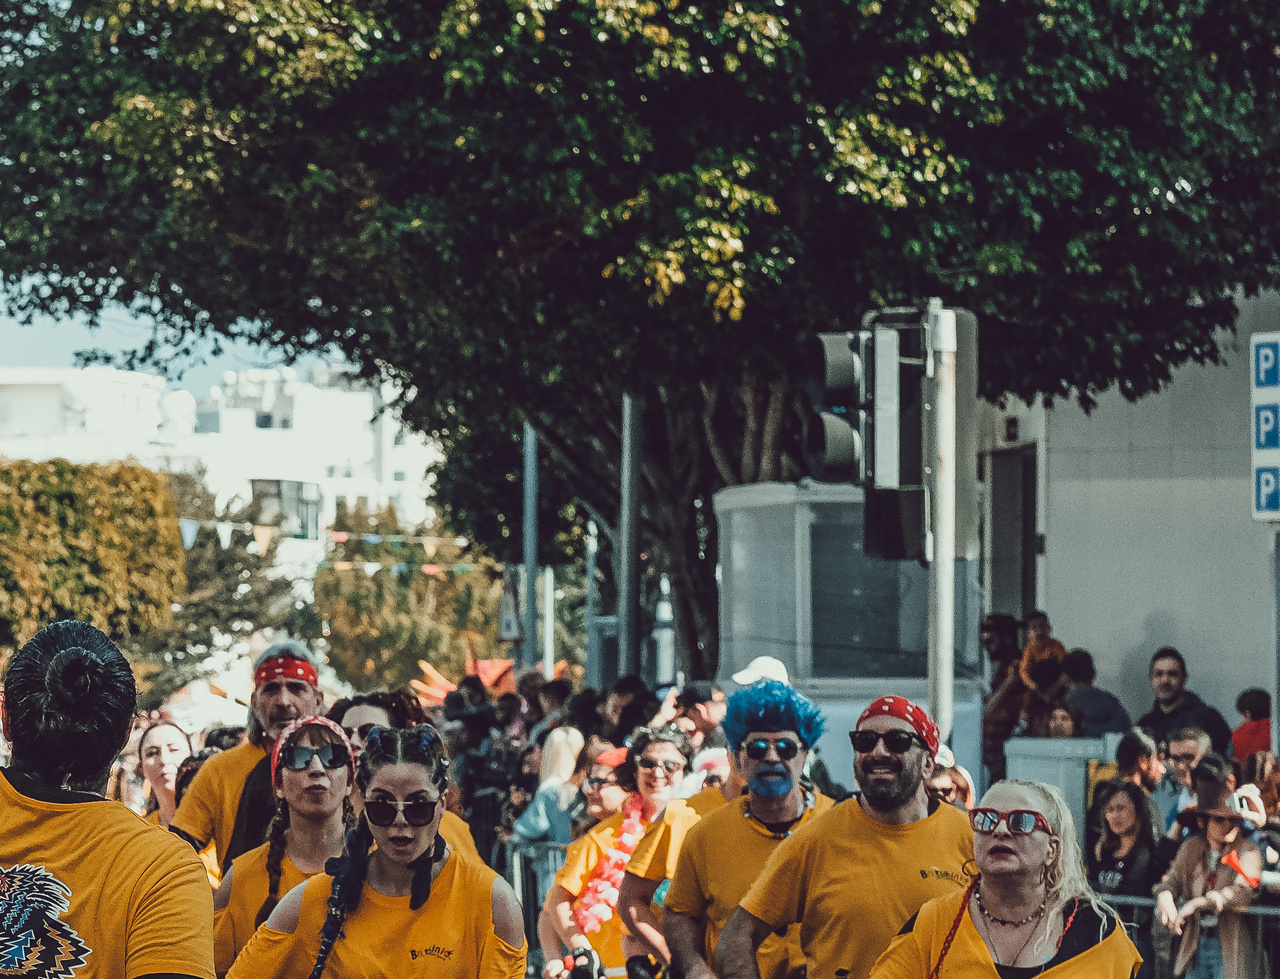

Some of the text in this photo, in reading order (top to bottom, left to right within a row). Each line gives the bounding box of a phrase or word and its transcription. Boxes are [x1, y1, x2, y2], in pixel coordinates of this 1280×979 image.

[1259, 347, 1275, 383] P
[1259, 410, 1274, 445] P
[1260, 472, 1275, 510] P
